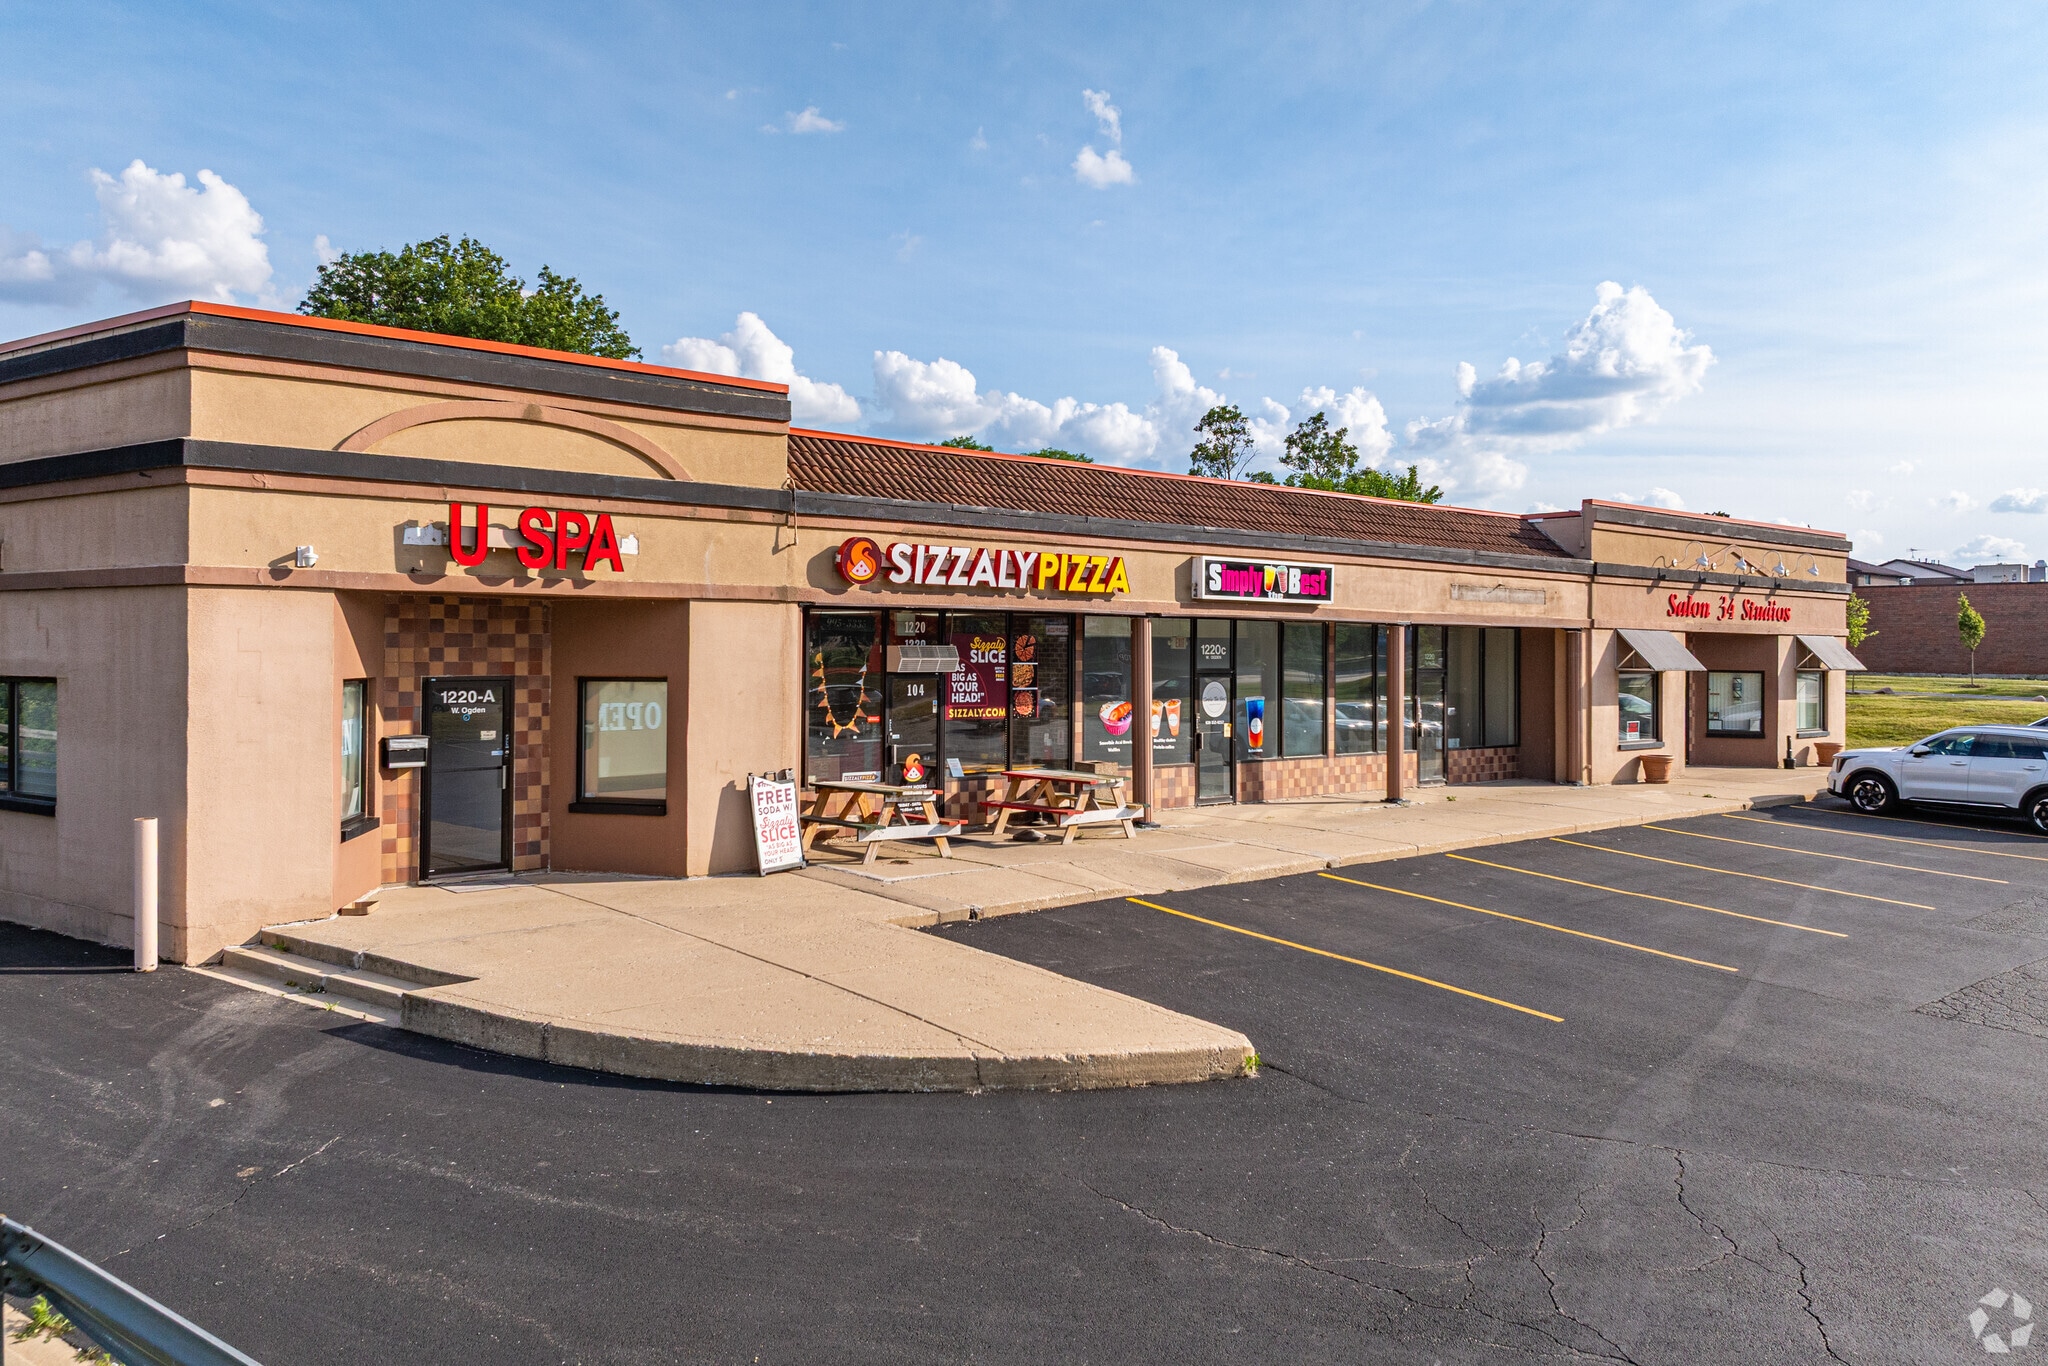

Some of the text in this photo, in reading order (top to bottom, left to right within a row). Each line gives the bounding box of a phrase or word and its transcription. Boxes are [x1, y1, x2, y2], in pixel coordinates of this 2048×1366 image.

[449, 502, 624, 572] U SPA
[1209, 563, 1328, 597] Simply Best
[1667, 593, 1792, 622] Salon 34 Studios
[904, 621, 926, 633] 1220
[970, 636, 1006, 652] Sizzaly
[1201, 644, 1226, 655] 1220c
[970, 650, 1006, 664] SLICE
[951, 673, 977, 681] BIG AS
[907, 684, 924, 697] 104
[951, 682, 978, 692] YOUR
[440, 689, 496, 704] 1220-A
[461, 706, 486, 715] Ogden
[948, 708, 1006, 718] SIZZALY.COM
[757, 788, 792, 806] FREE
[758, 806, 781, 815] SODA
[760, 813, 795, 830] Sizzaly
[761, 826, 796, 843] SLICE
